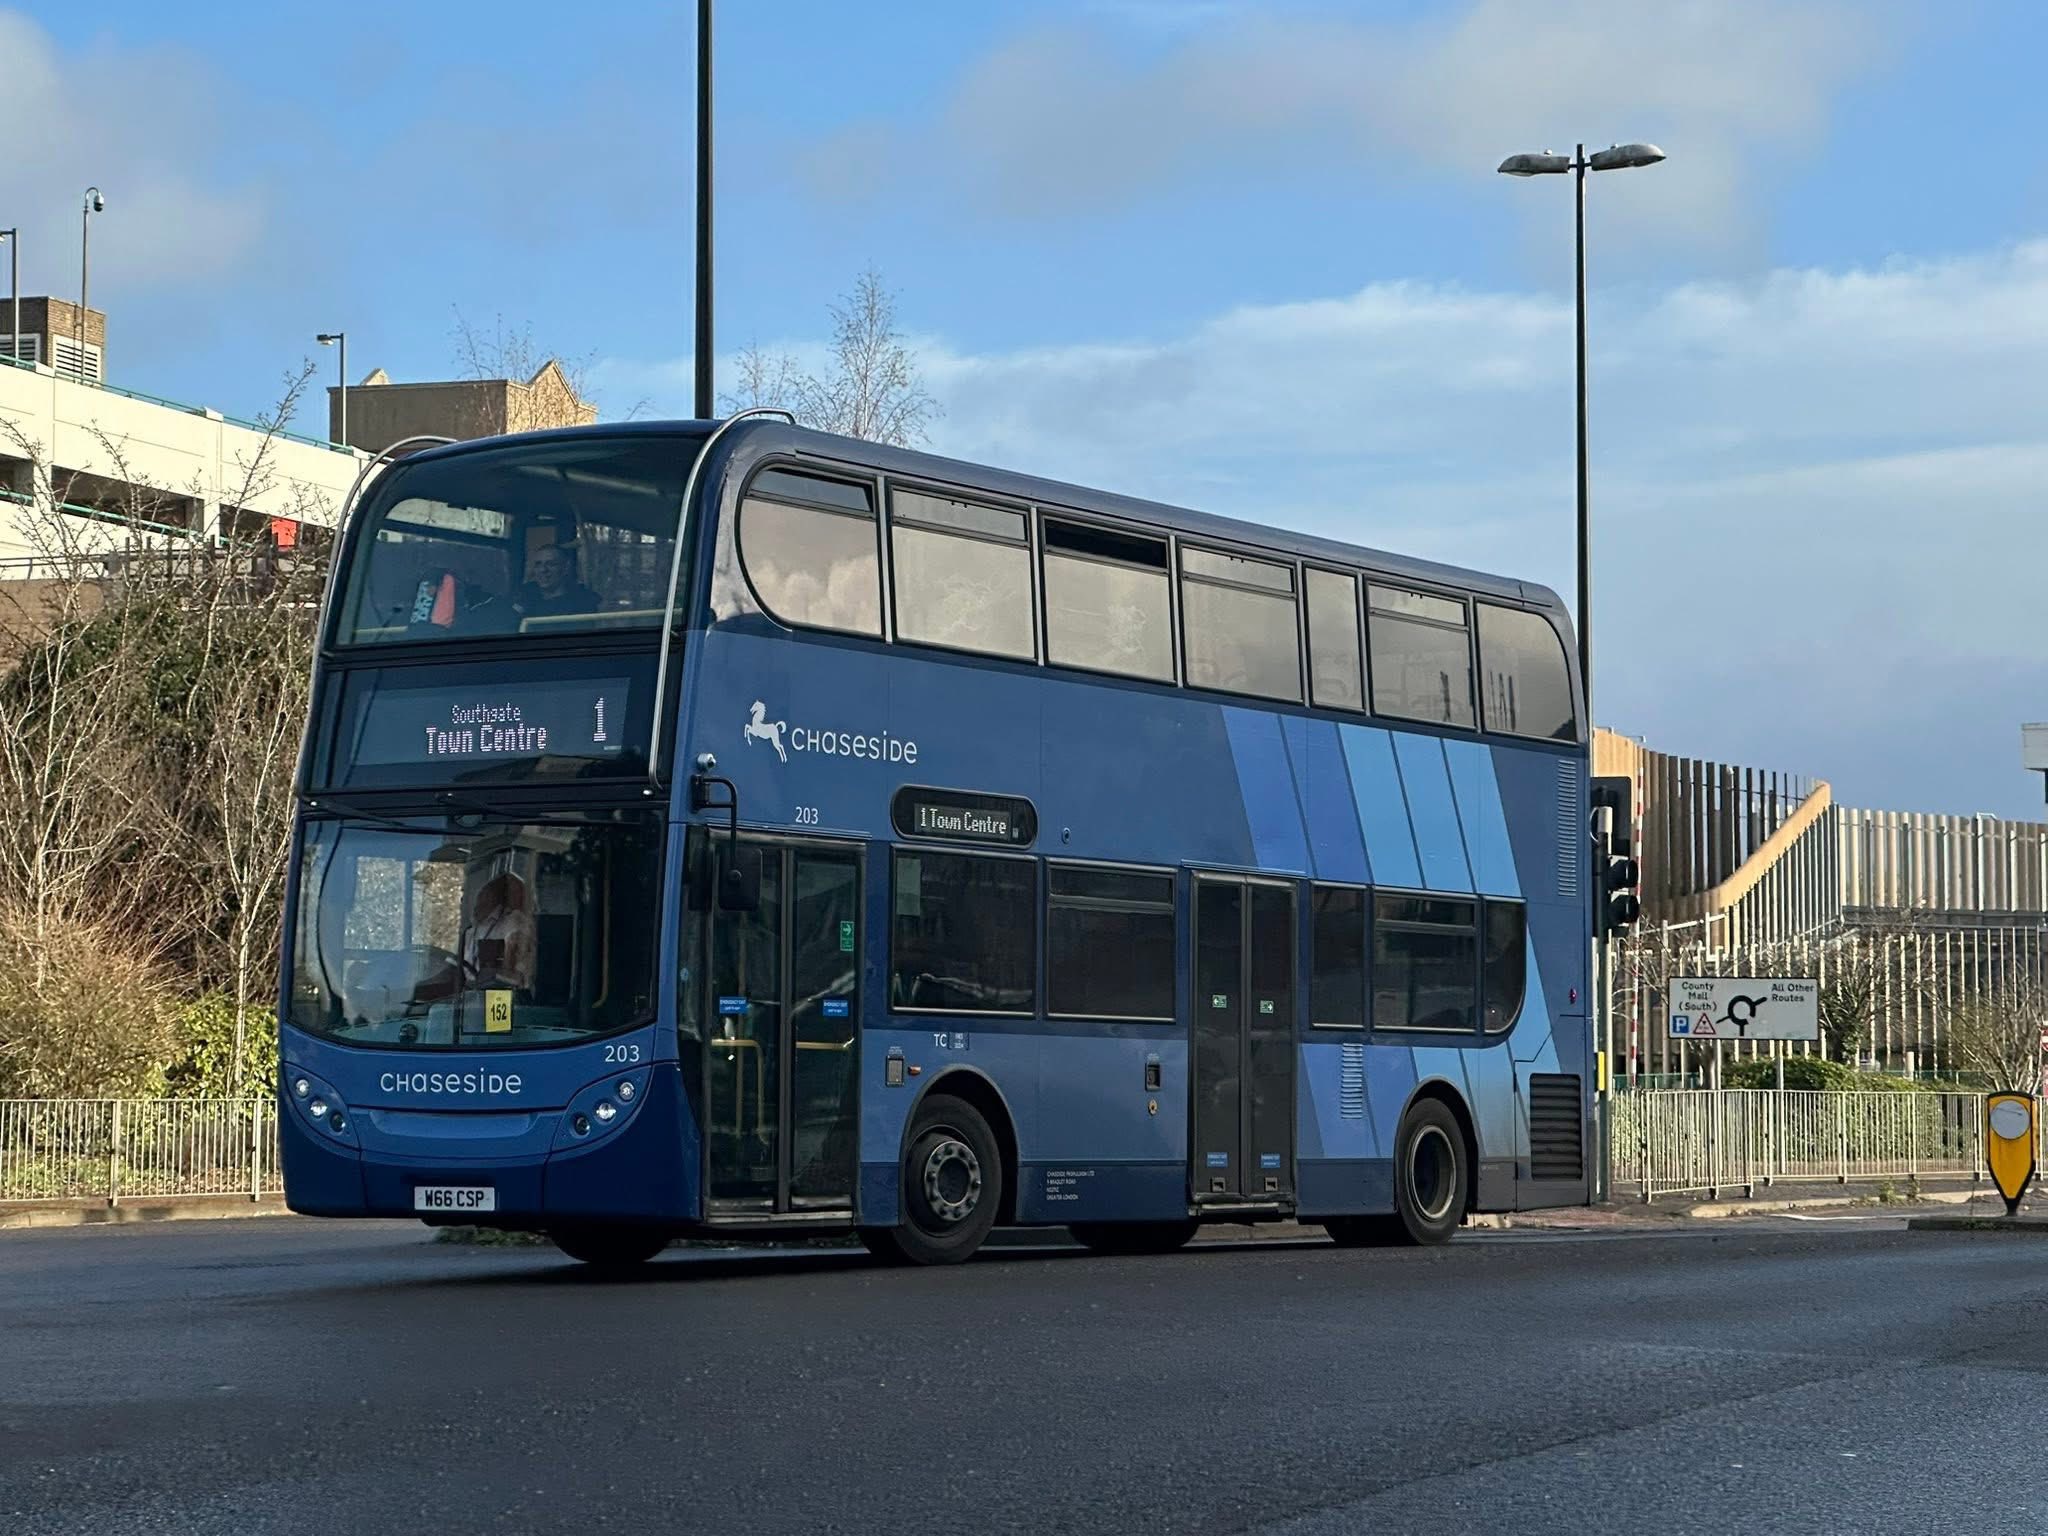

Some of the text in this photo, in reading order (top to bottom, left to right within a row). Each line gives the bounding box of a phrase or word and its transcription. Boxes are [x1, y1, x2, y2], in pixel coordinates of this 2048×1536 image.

[451, 702, 521, 724] Southgate
[593, 697, 607, 742] 1
[425, 723, 547, 754] Town Centre
[795, 806, 819, 824] 203
[920, 807, 1007, 834] 1 Town Centre
[1681, 981, 1714, 992] County
[1688, 991, 1708, 1000] Mall
[1771, 983, 1814, 992] All Other
[1678, 1001, 1718, 1012] (South)
[1771, 993, 1805, 1002] Routes
[491, 1003, 507, 1021] 152
[1675, 1017, 1687, 1031] P
[933, 1033, 947, 1047] TC
[604, 1045, 640, 1063] 203
[425, 1190, 484, 1208] W66 CSP
